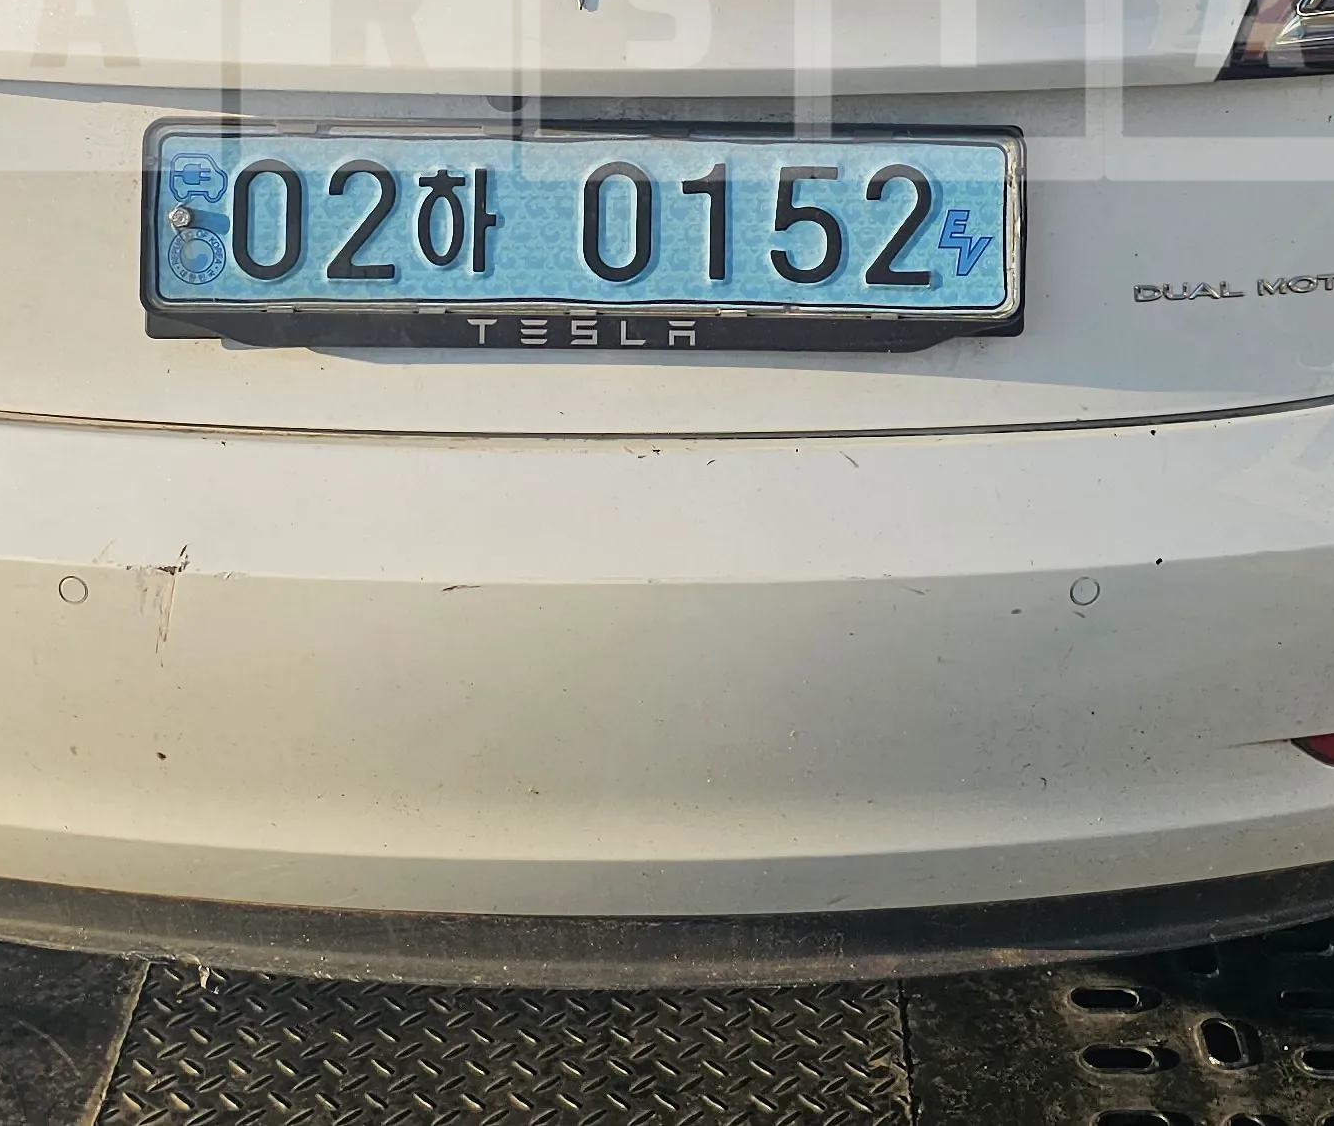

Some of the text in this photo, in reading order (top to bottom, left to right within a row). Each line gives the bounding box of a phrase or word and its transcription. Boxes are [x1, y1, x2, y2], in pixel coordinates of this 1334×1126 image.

[231, 158, 934, 286] 02하 0152
[938, 209, 994, 277] EV
[1133, 280, 1245, 302] DUAL
[466, 318, 697, 348] TESLA
